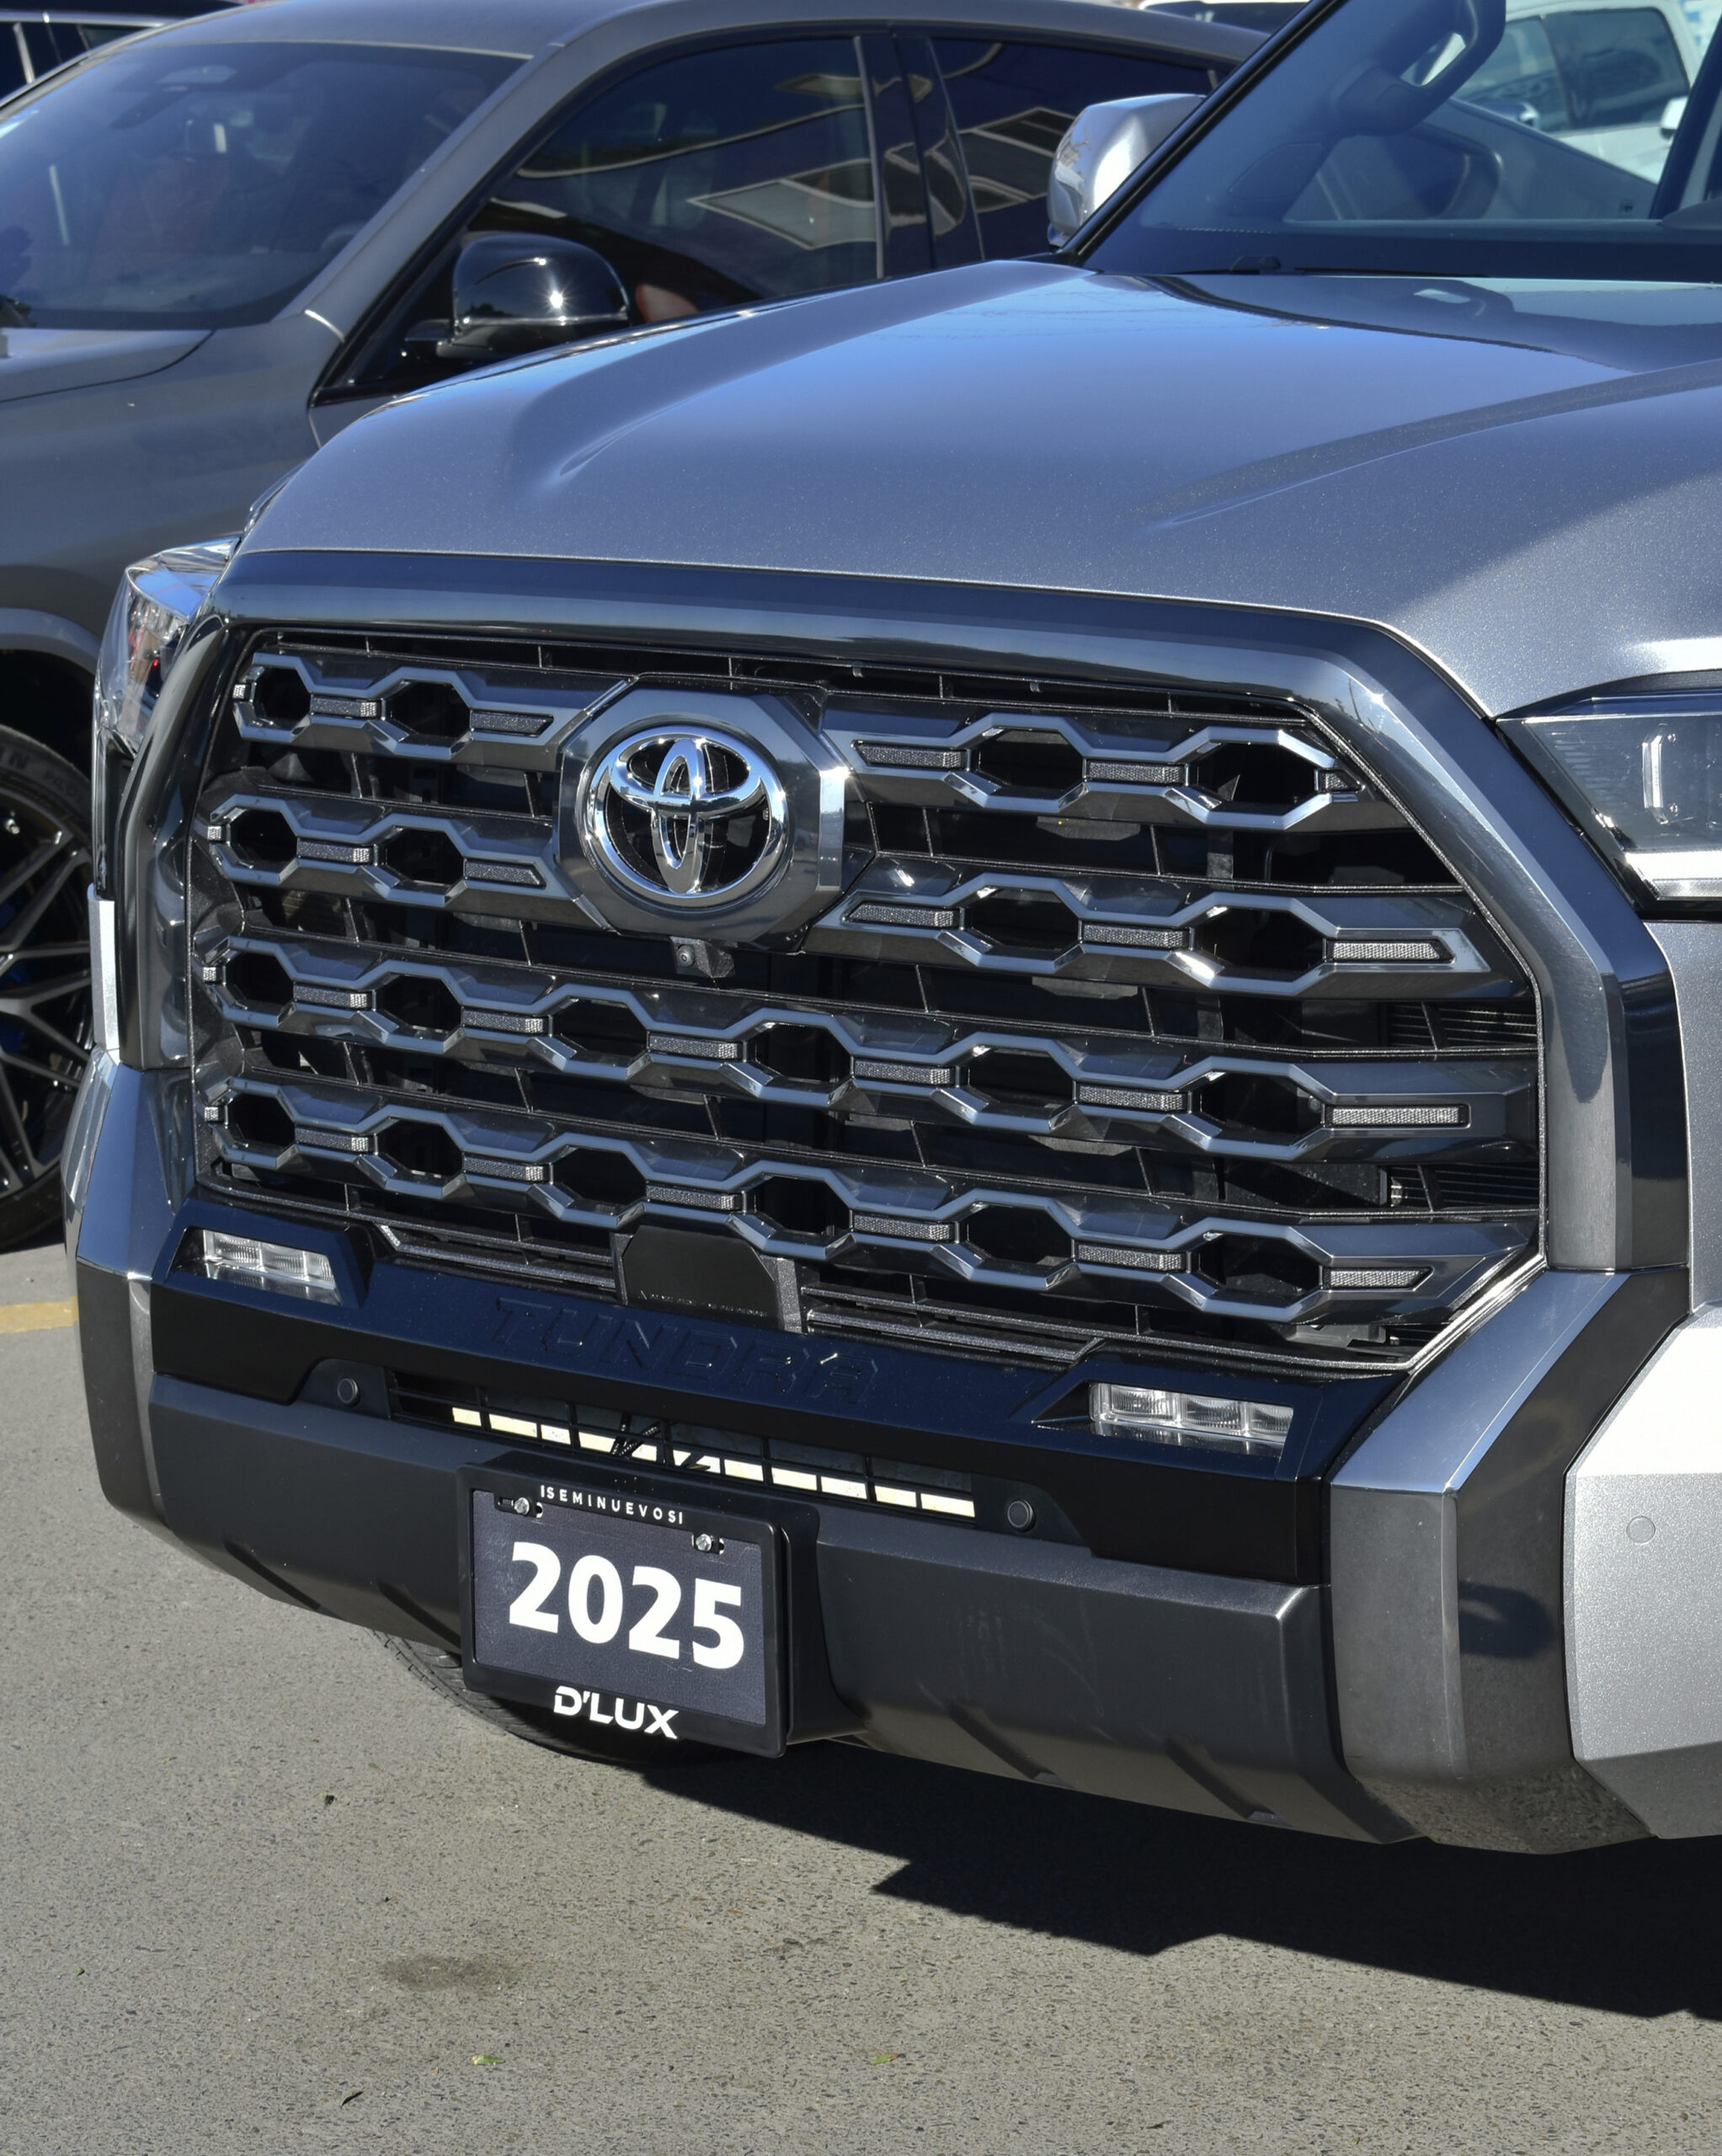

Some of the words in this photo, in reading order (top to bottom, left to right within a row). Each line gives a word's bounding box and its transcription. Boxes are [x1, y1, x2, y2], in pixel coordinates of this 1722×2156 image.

[492, 1297, 878, 1403] TUNDRA
[509, 1541, 744, 1669] 2025
[553, 1685, 680, 1740] D'LUX
